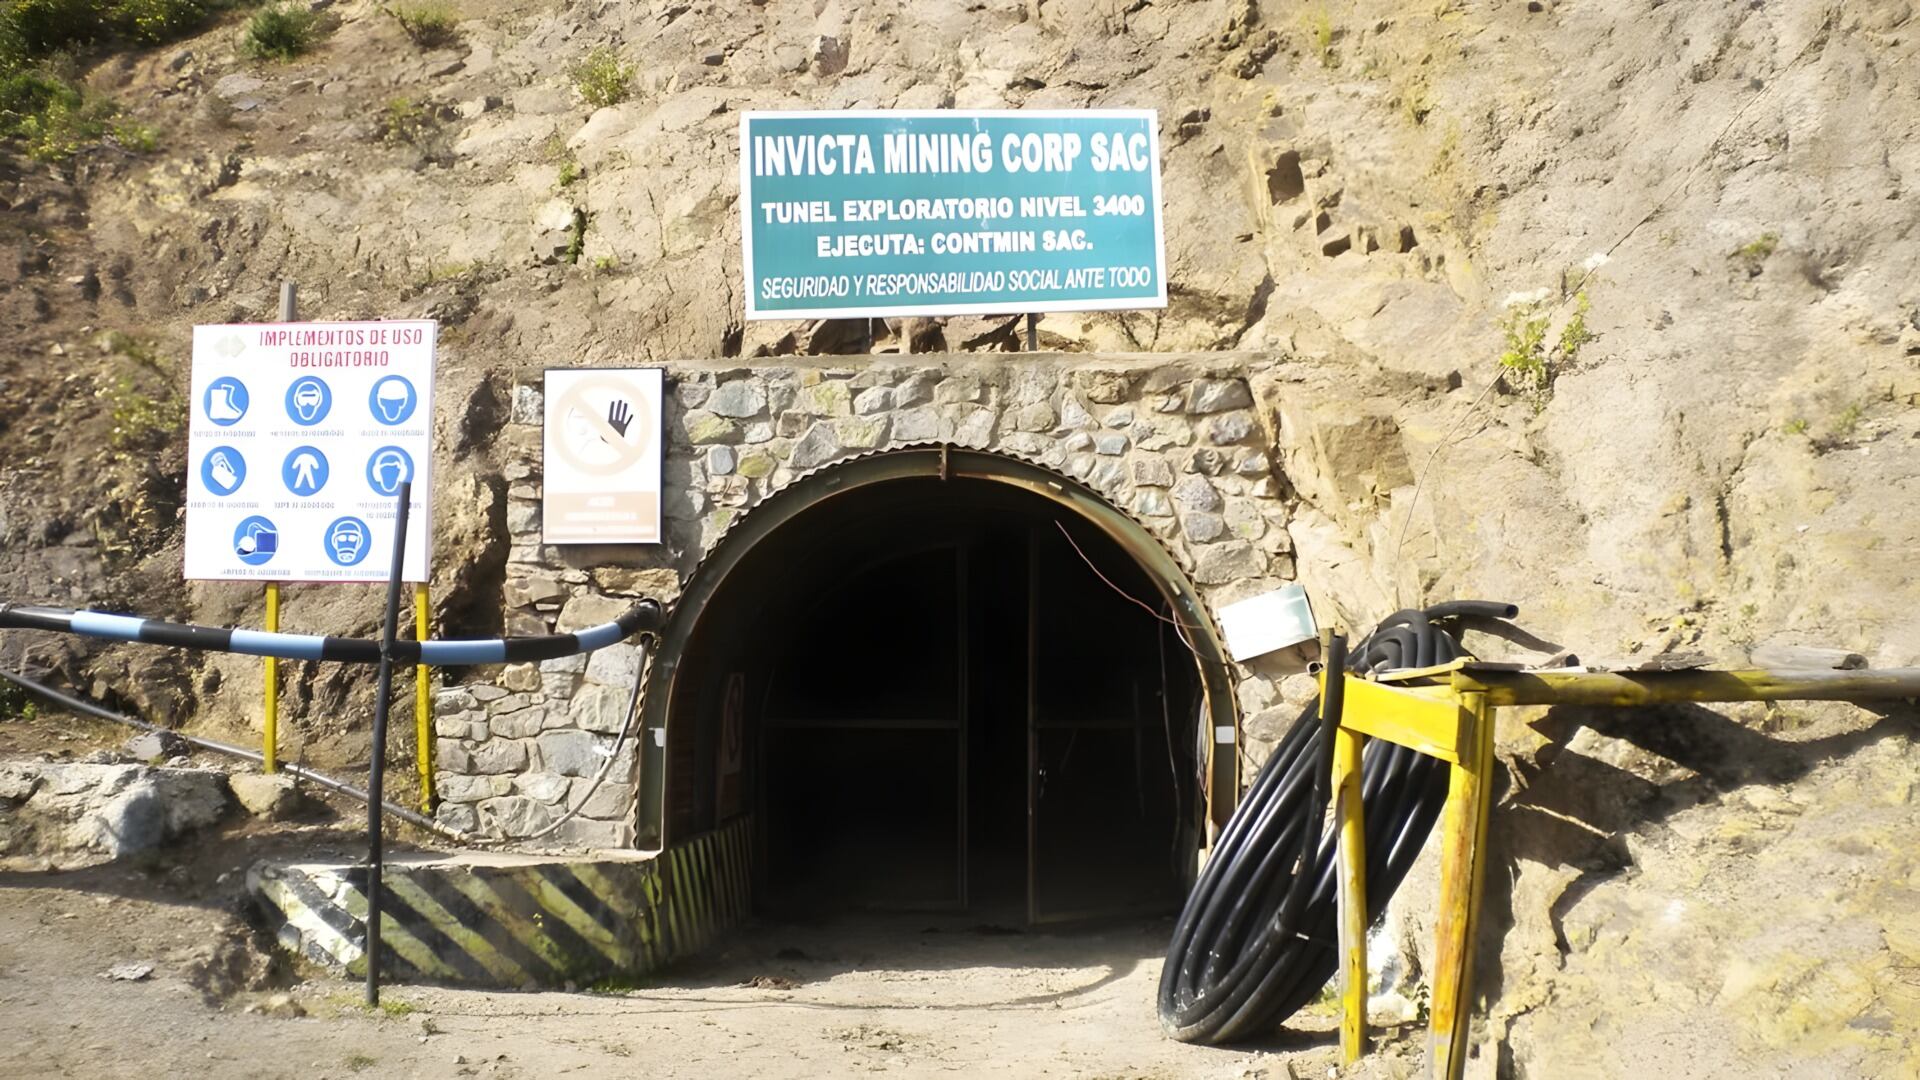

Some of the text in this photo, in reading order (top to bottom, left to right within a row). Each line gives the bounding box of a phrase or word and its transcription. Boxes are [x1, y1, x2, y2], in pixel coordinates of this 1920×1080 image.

[754, 132, 1149, 177] INVICTA MINING CORP SAC
[762, 195, 1145, 223] TUNEL EXPLORATORIO NIVEL 3400
[816, 230, 1093, 257] EJECUTA: CONTMIN SAC.
[761, 266, 1151, 299] SEGURIDAD Y RESPONSABILIDAD SOCIAL ANTE TODO
[259, 328, 422, 347] IMPLEMENTOS DE USO
[290, 351, 389, 368] OBLIGATORIO
